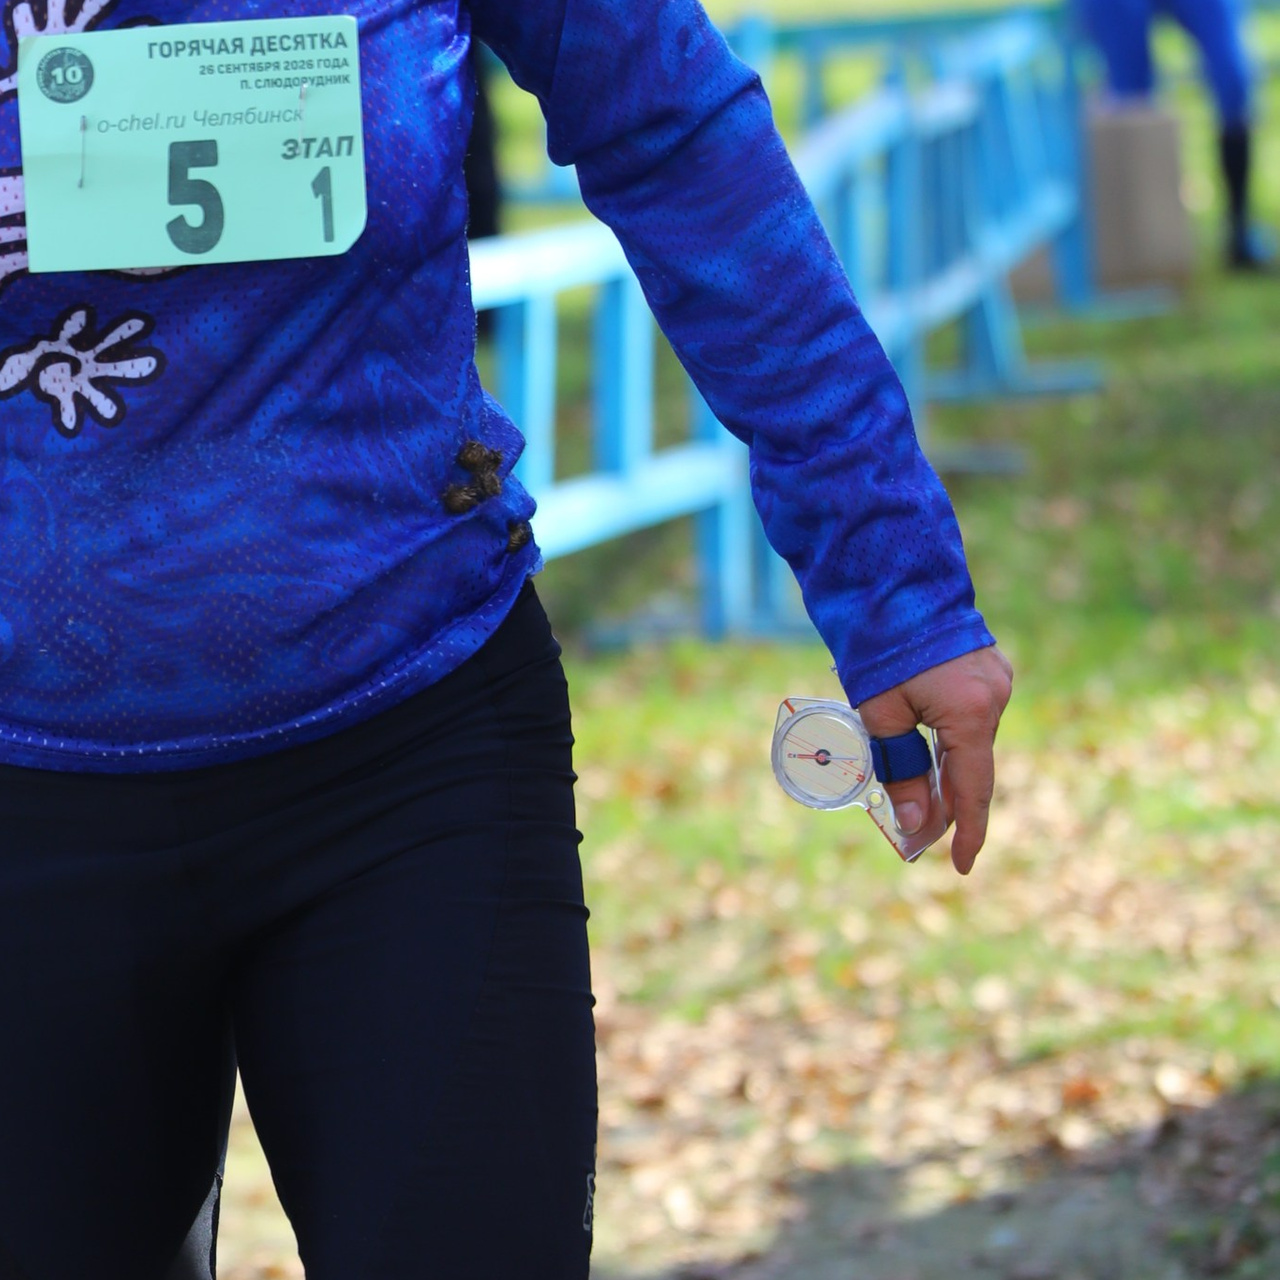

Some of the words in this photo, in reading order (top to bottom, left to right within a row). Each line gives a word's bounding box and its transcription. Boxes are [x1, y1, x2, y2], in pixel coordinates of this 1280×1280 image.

[147, 37, 245, 59] ГОРЯЧАЯ
[250, 32, 348, 56] ДЕСЯТКА
[50, 67, 82, 85] 10
[199, 65, 215, 75] 26
[217, 61, 280, 74] СЕНТЯБРЯ
[317, 57, 349, 70] ГОДА
[240, 79, 252, 90] П.
[255, 74, 351, 90] СЛЮДОРУДНИК
[97, 114, 186, 133] o-chel.ru
[193, 107, 304, 127] Челябинск
[281, 135, 354, 160] ЭТАП
[165, 139, 225, 255] 5
[311, 166, 335, 243] 1
